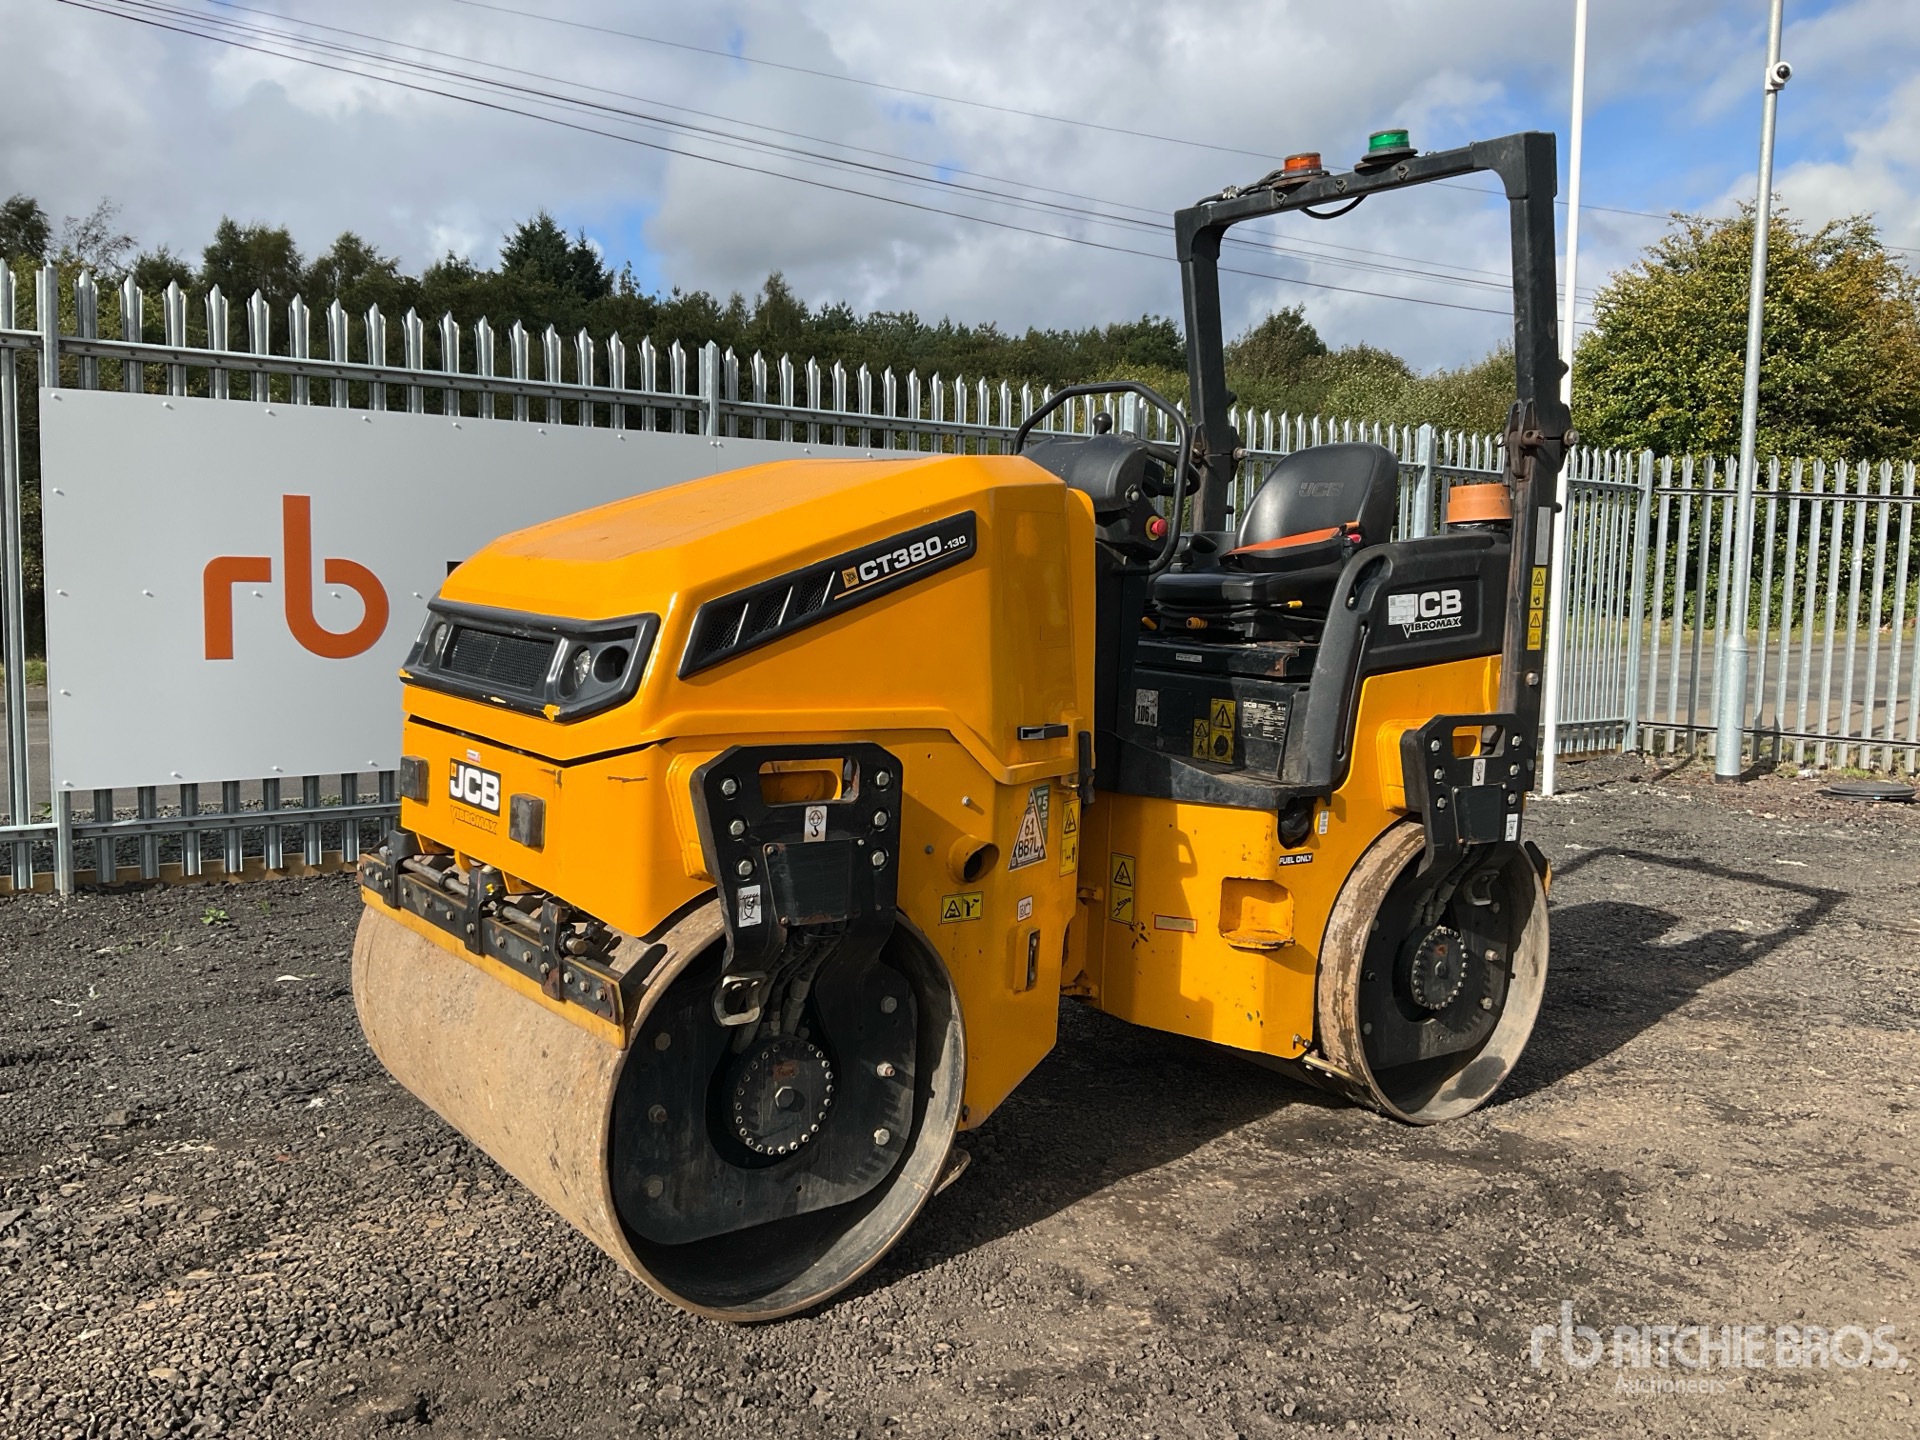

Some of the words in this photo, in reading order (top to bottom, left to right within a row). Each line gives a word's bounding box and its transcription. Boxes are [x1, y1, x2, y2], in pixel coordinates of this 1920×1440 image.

[1298, 482, 1344, 497] JCB
[203, 494, 390, 660] rb
[1402, 616, 1462, 639] VIBROMAX
[1137, 704, 1150, 723] 106
[449, 765, 500, 811] JCB
[450, 804, 498, 835] VIBROMAX
[1279, 856, 1295, 865] FUEL
[1296, 854, 1313, 863] ONLY
